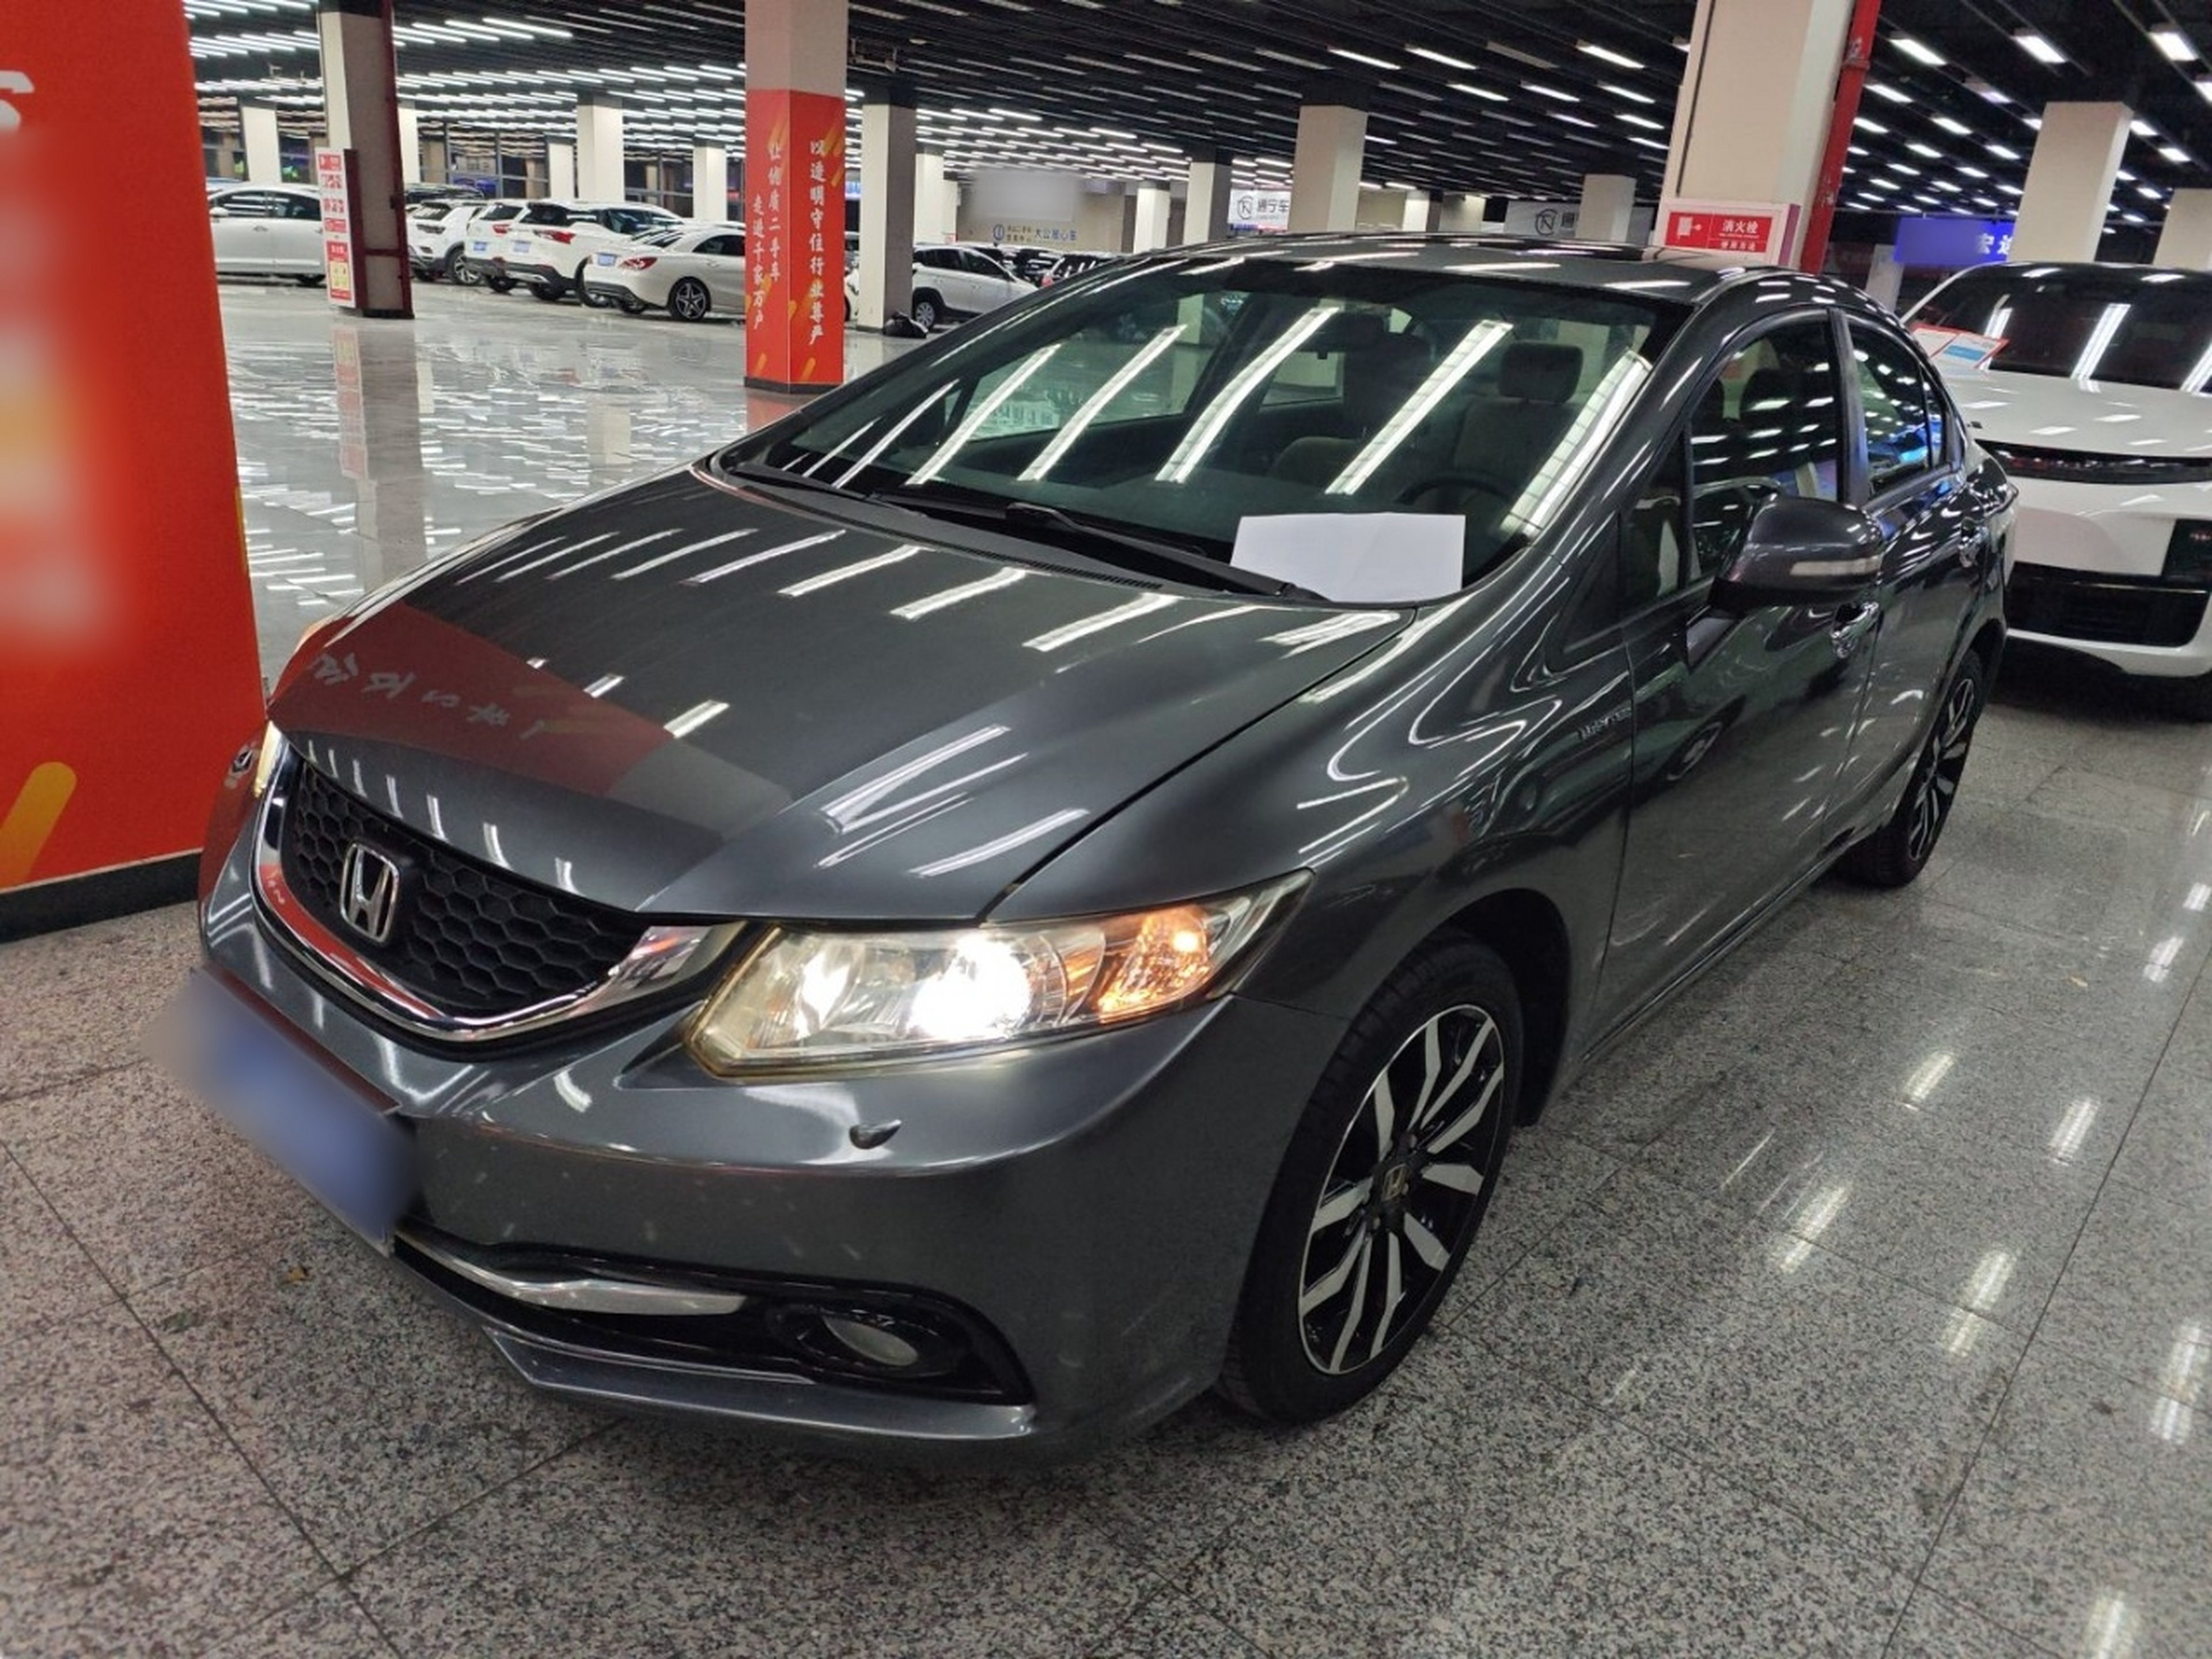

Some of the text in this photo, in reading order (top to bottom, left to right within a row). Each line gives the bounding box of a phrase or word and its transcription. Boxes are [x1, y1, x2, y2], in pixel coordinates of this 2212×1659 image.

[809, 139, 826, 344] 以透明守住行业尊严
[1722, 218, 1759, 234] 消火栓
